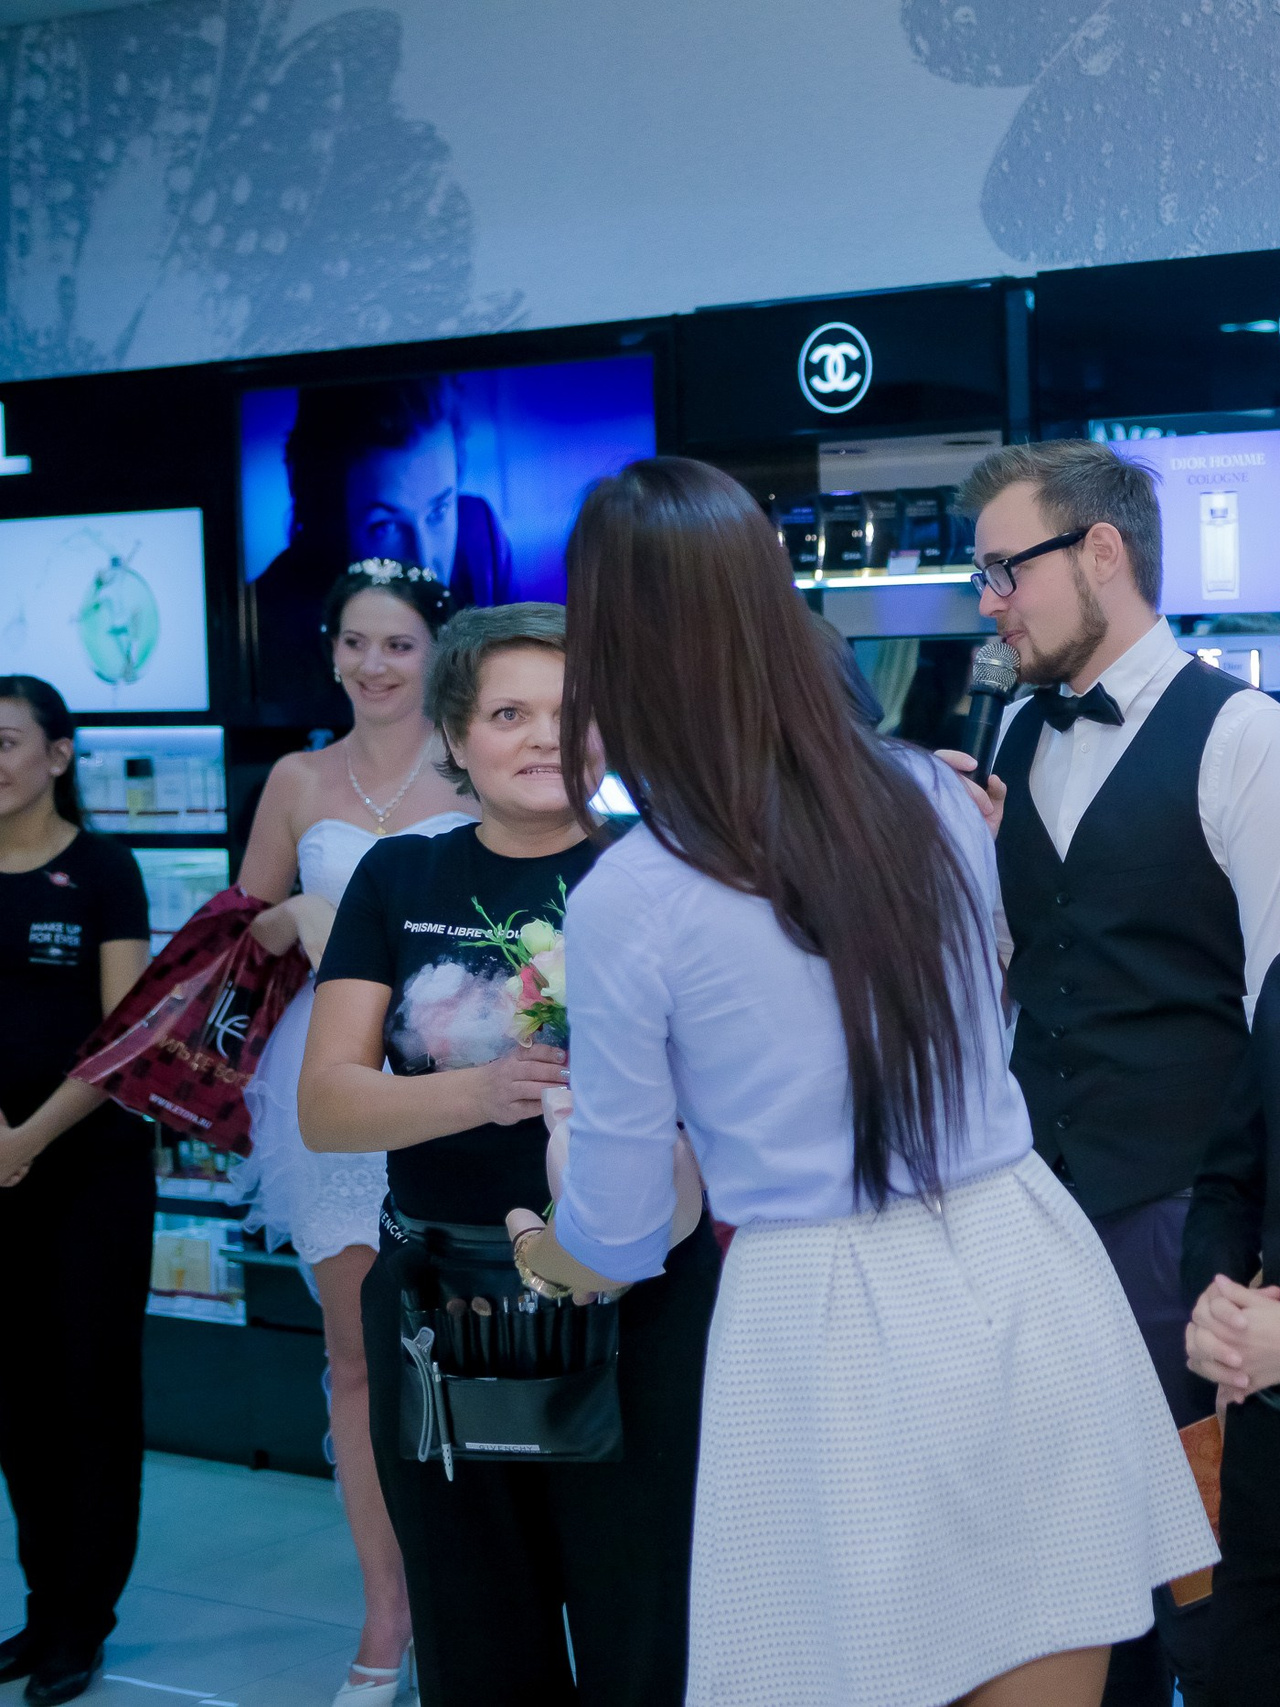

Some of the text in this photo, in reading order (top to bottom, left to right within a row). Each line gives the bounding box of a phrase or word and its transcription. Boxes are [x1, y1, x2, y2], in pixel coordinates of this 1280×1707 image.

[1170, 453, 1266, 471] DIOR HOMME
[1187, 472, 1249, 486] COLOGNE
[404, 920, 446, 934] PRISME
[447, 926, 482, 938] LIBRE
